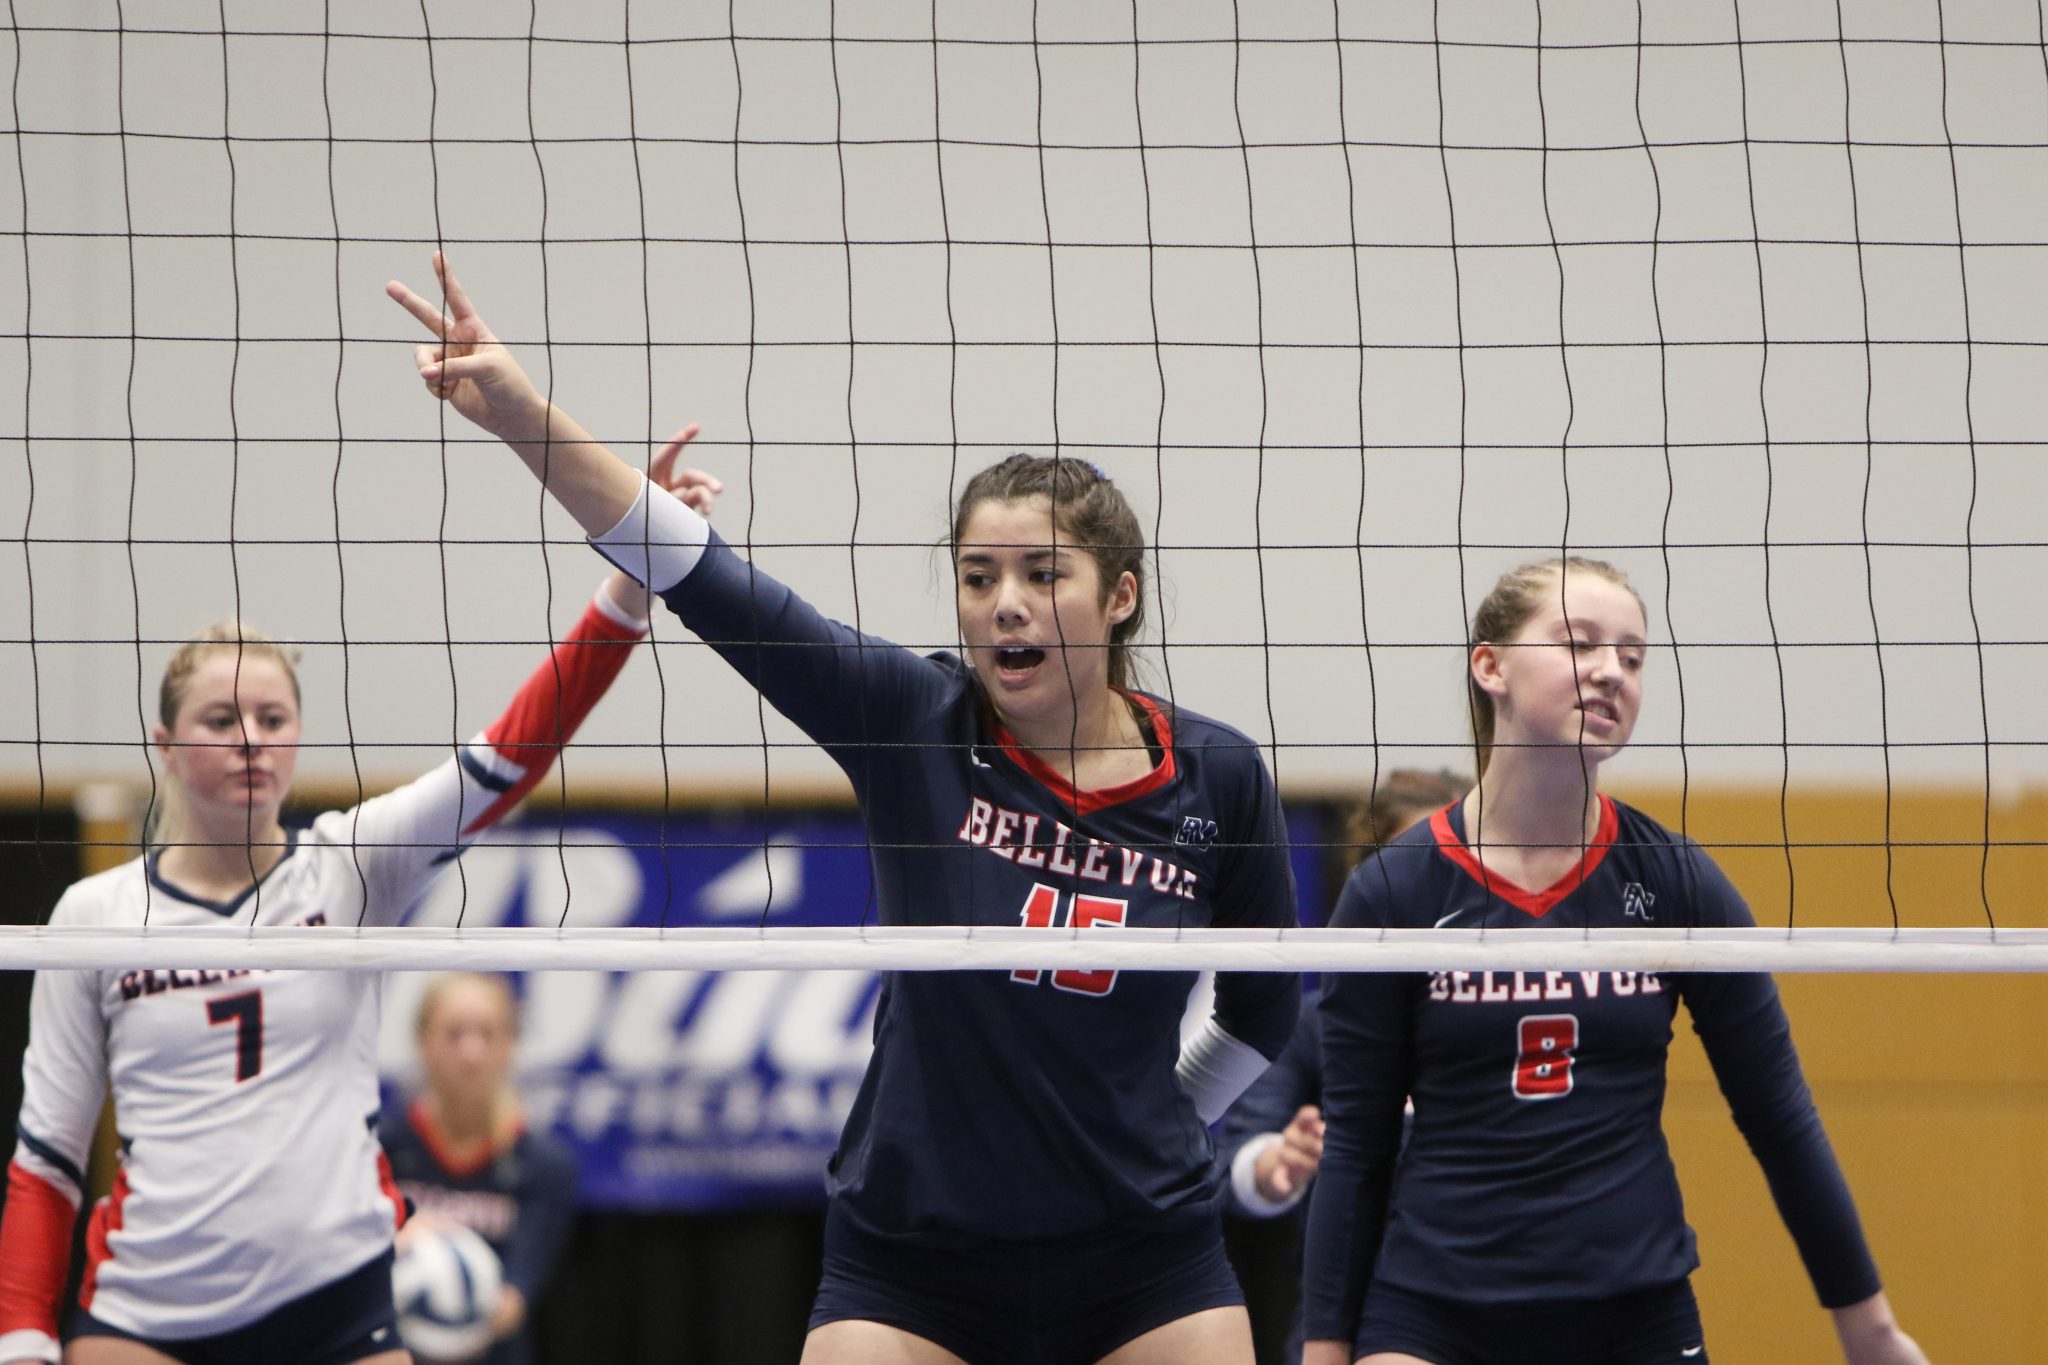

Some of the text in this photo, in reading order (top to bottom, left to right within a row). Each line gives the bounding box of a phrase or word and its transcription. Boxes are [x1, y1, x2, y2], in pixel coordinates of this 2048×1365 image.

[958, 797, 1198, 900] BELLEVUE
[1010, 882, 1128, 997] 15
[205, 987, 263, 1083] 7
[1512, 1014, 1579, 1099] 8
